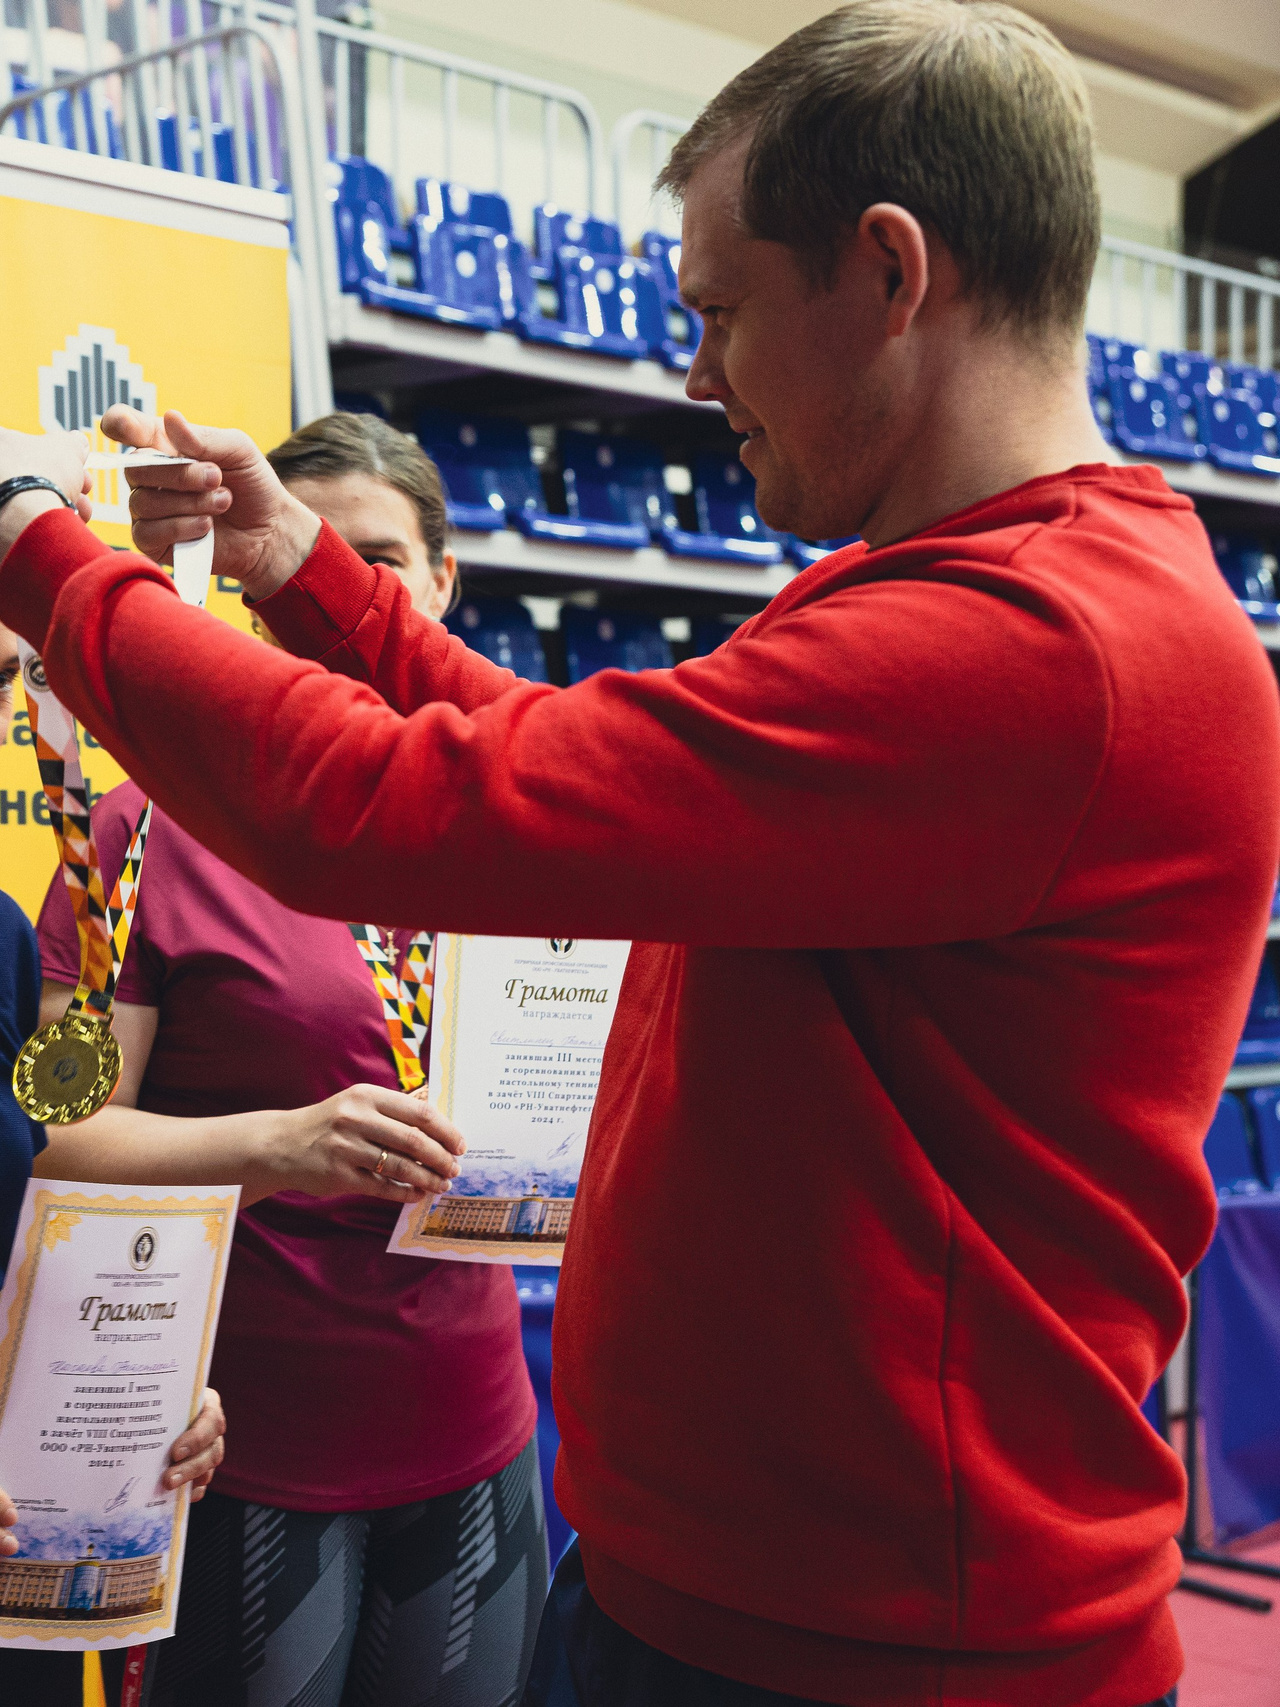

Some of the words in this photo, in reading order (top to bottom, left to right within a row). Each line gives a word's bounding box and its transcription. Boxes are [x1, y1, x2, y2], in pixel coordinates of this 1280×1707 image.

[505, 978, 609, 1008] Грамота
[522, 1009, 593, 1020] награждается
[505, 1054, 553, 1062] занявшая
[557, 1053, 572, 1062] III
[513, 1067, 586, 1076] соревнованиях
[499, 1079, 562, 1089] настольному
[496, 1090, 523, 1098] зачёт
[526, 1091, 545, 1099] VIII
[548, 1092, 596, 1101] Спартаки
[489, 1102, 511, 1110] ООО
[531, 1116, 553, 1124] 2024
[78, 1296, 179, 1331] Грамота
[127, 1381, 135, 1393] I
[40, 1429, 48, 1437] в
[49, 1428, 84, 1438] зачёт
[85, 1429, 109, 1438] VIII
[40, 1442, 68, 1453] ООО
[88, 1459, 115, 1468] 2024
